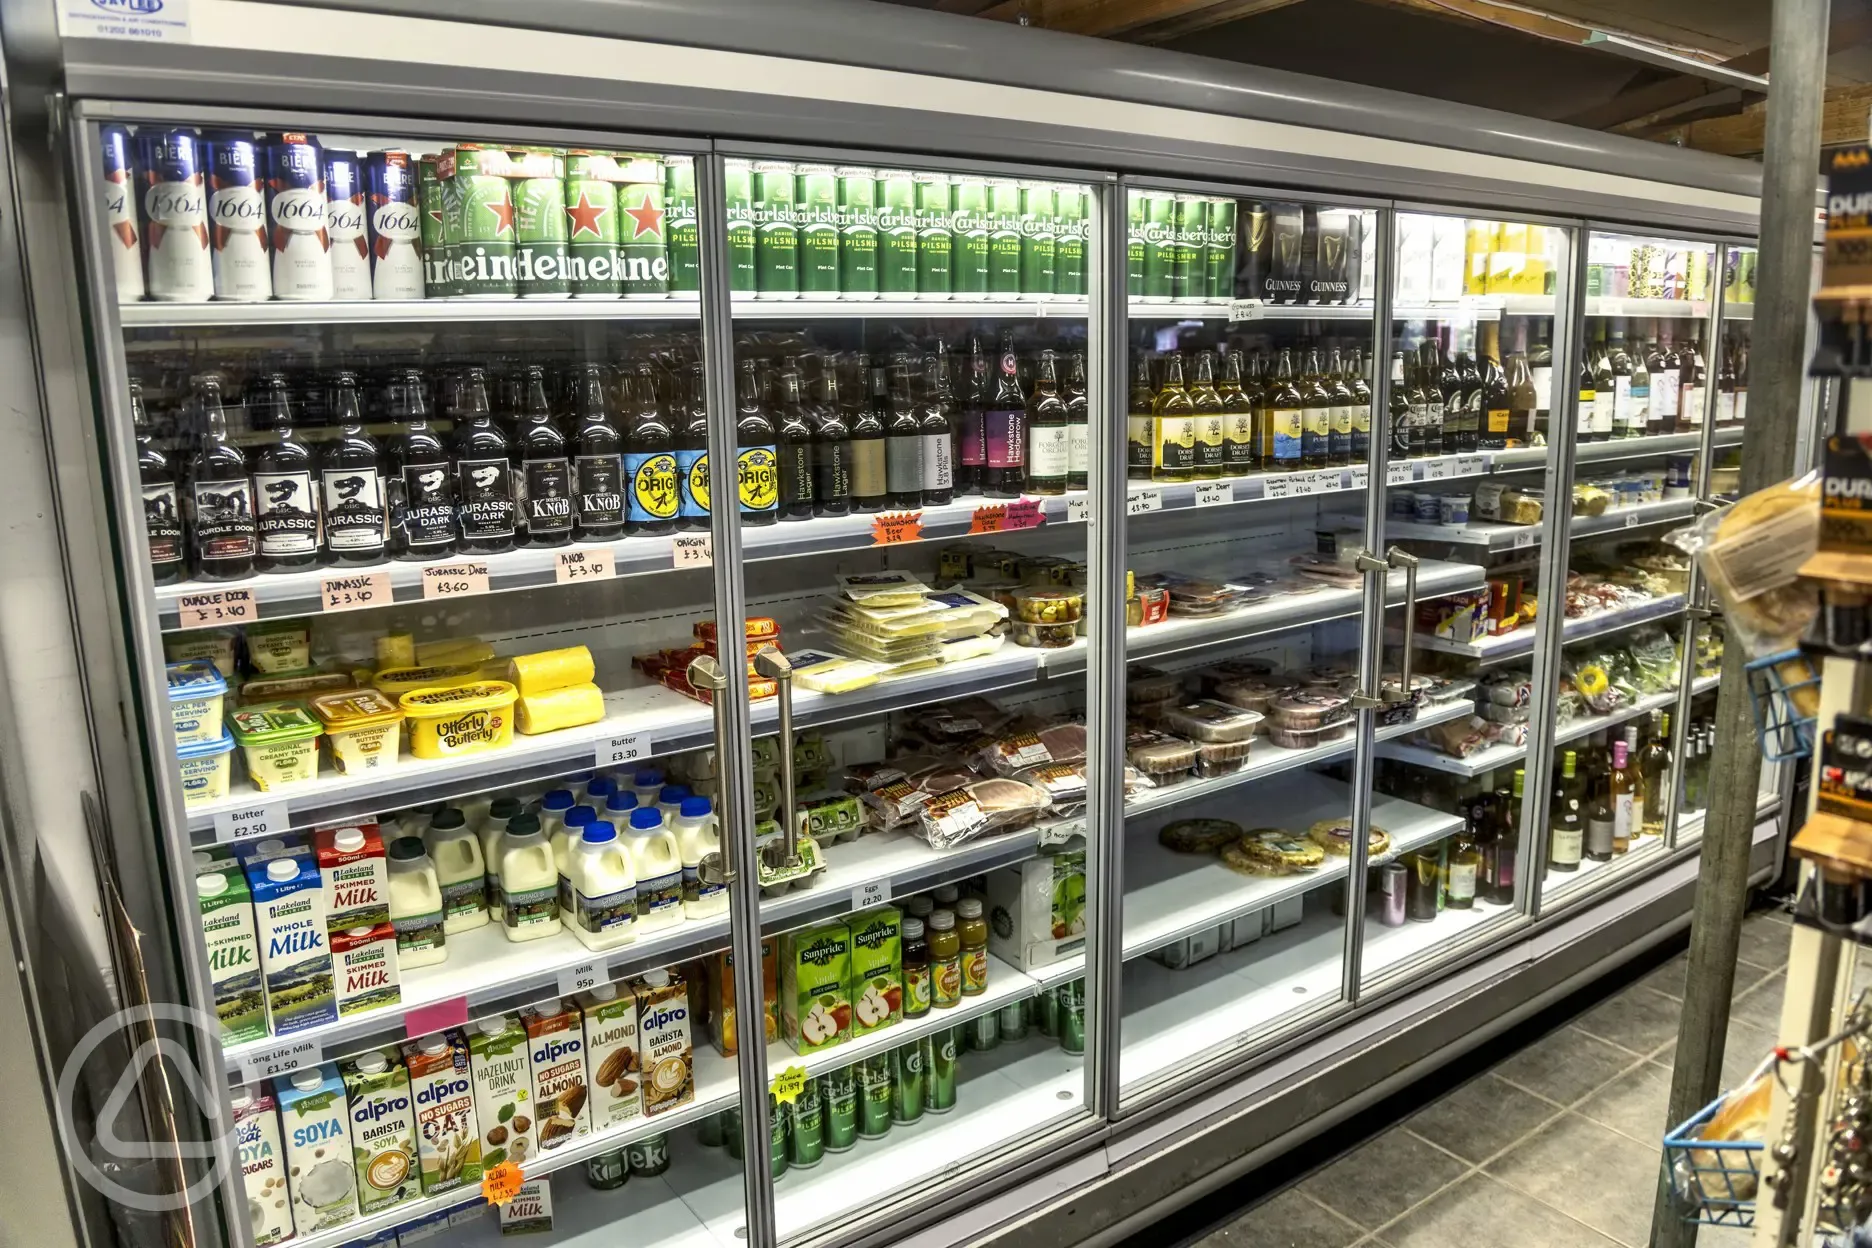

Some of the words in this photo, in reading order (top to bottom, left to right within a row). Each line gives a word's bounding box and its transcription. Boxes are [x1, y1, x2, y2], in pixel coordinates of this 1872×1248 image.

[151, 193, 202, 214] 1664
[215, 199, 264, 218] 1664
[277, 200, 325, 219] 1664
[379, 212, 419, 232] 1664
[1265, 277, 1301, 291] GUINNESS
[1310, 279, 1347, 292] GUINNESS
[1007, 413, 1015, 463] Hawkstone
[1014, 416, 1022, 463] Hedgerow
[797, 447, 805, 501] Hawkstone
[832, 445, 841, 498] Hawkstone
[804, 472, 812, 501] Lager
[461, 501, 513, 514] JURASSIC
[531, 498, 570, 518] KNOB
[583, 494, 621, 512] KNOB
[327, 514, 383, 528] JURASSIC
[421, 515, 450, 527] DARK
[473, 510, 506, 521] DARK
[160, 528, 181, 536] DOOR
[199, 525, 232, 537] DURDLE
[235, 524, 254, 532] DOOR
[258, 519, 316, 532] JURASSIC
[561, 552, 586, 564] KNOB
[437, 582, 469, 593] £3.60
[171, 703, 191, 711] KCAL
[192, 701, 207, 709] PER
[175, 721, 199, 730] FLORA
[436, 715, 485, 737] Utterly
[349, 727, 390, 739] DELICIOUSLY
[356, 734, 385, 743] BUTTERY
[444, 728, 493, 748] Butterly
[268, 743, 302, 753] ORIGINAL
[360, 743, 382, 752] FLORA
[611, 735, 636, 747] Butter
[259, 751, 287, 761] CREAMY
[288, 748, 311, 756] TASTE
[612, 748, 638, 762] £3.30
[180, 761, 198, 769] KCAL
[200, 759, 215, 767] PER
[275, 758, 298, 767] FLORA
[183, 778, 207, 788] FLORA
[232, 808, 265, 822] Butter
[234, 823, 267, 838] £2.50
[338, 854, 360, 863] 500ml
[340, 864, 374, 875] Lakeland
[280, 884, 296, 892] Litre
[334, 879, 375, 890] SKIMMED
[864, 882, 879, 894] Eggs
[333, 889, 378, 909] Milk
[518, 891, 544, 901] CRAIG'S
[862, 893, 882, 907] £2.20
[276, 898, 311, 911] Lakeland
[204, 913, 240, 927] Lakeland
[273, 919, 313, 933] WHOLE
[400, 918, 427, 928] CRAIG'S
[610, 915, 623, 923] WHOLE
[857, 926, 895, 944] Sunpride
[269, 931, 323, 959] Milk
[350, 938, 371, 947] 500ml
[351, 947, 384, 959] Lakeland
[803, 943, 843, 961] Sunpride
[346, 961, 386, 974] SKIMMED
[575, 964, 594, 976] Milk
[346, 971, 389, 993] Milk
[576, 977, 594, 990] 95p
[643, 1007, 687, 1032] alpro
[591, 1024, 636, 1048] ALMOND
[649, 1028, 684, 1048] BARISTA
[247, 1052, 271, 1065] Long
[273, 1049, 290, 1059] Life
[292, 1042, 315, 1054] Milk
[533, 1039, 581, 1064] alpro
[653, 1042, 682, 1059] ALMOND
[267, 1060, 298, 1075] £1.50
[477, 1057, 525, 1082] HAZELNUT
[538, 1070, 550, 1081] NO
[550, 1061, 580, 1076] SUGARS
[489, 1074, 516, 1091] DRINK
[779, 1073, 802, 1083] Juice
[416, 1079, 469, 1105] alpro
[539, 1075, 583, 1098] ALMOND
[779, 1082, 800, 1094] £1.89
[354, 1096, 409, 1123] alpro
[420, 1110, 434, 1122] NO
[435, 1098, 471, 1116] SUGARS
[362, 1120, 405, 1140] BARISTA
[423, 1110, 471, 1140] OAT
[293, 1118, 343, 1148] SOYA
[374, 1135, 399, 1151] SOYA
[242, 1159, 273, 1176] SUGARS
[489, 1182, 505, 1192] MILK
[508, 1203, 543, 1219] Milk
